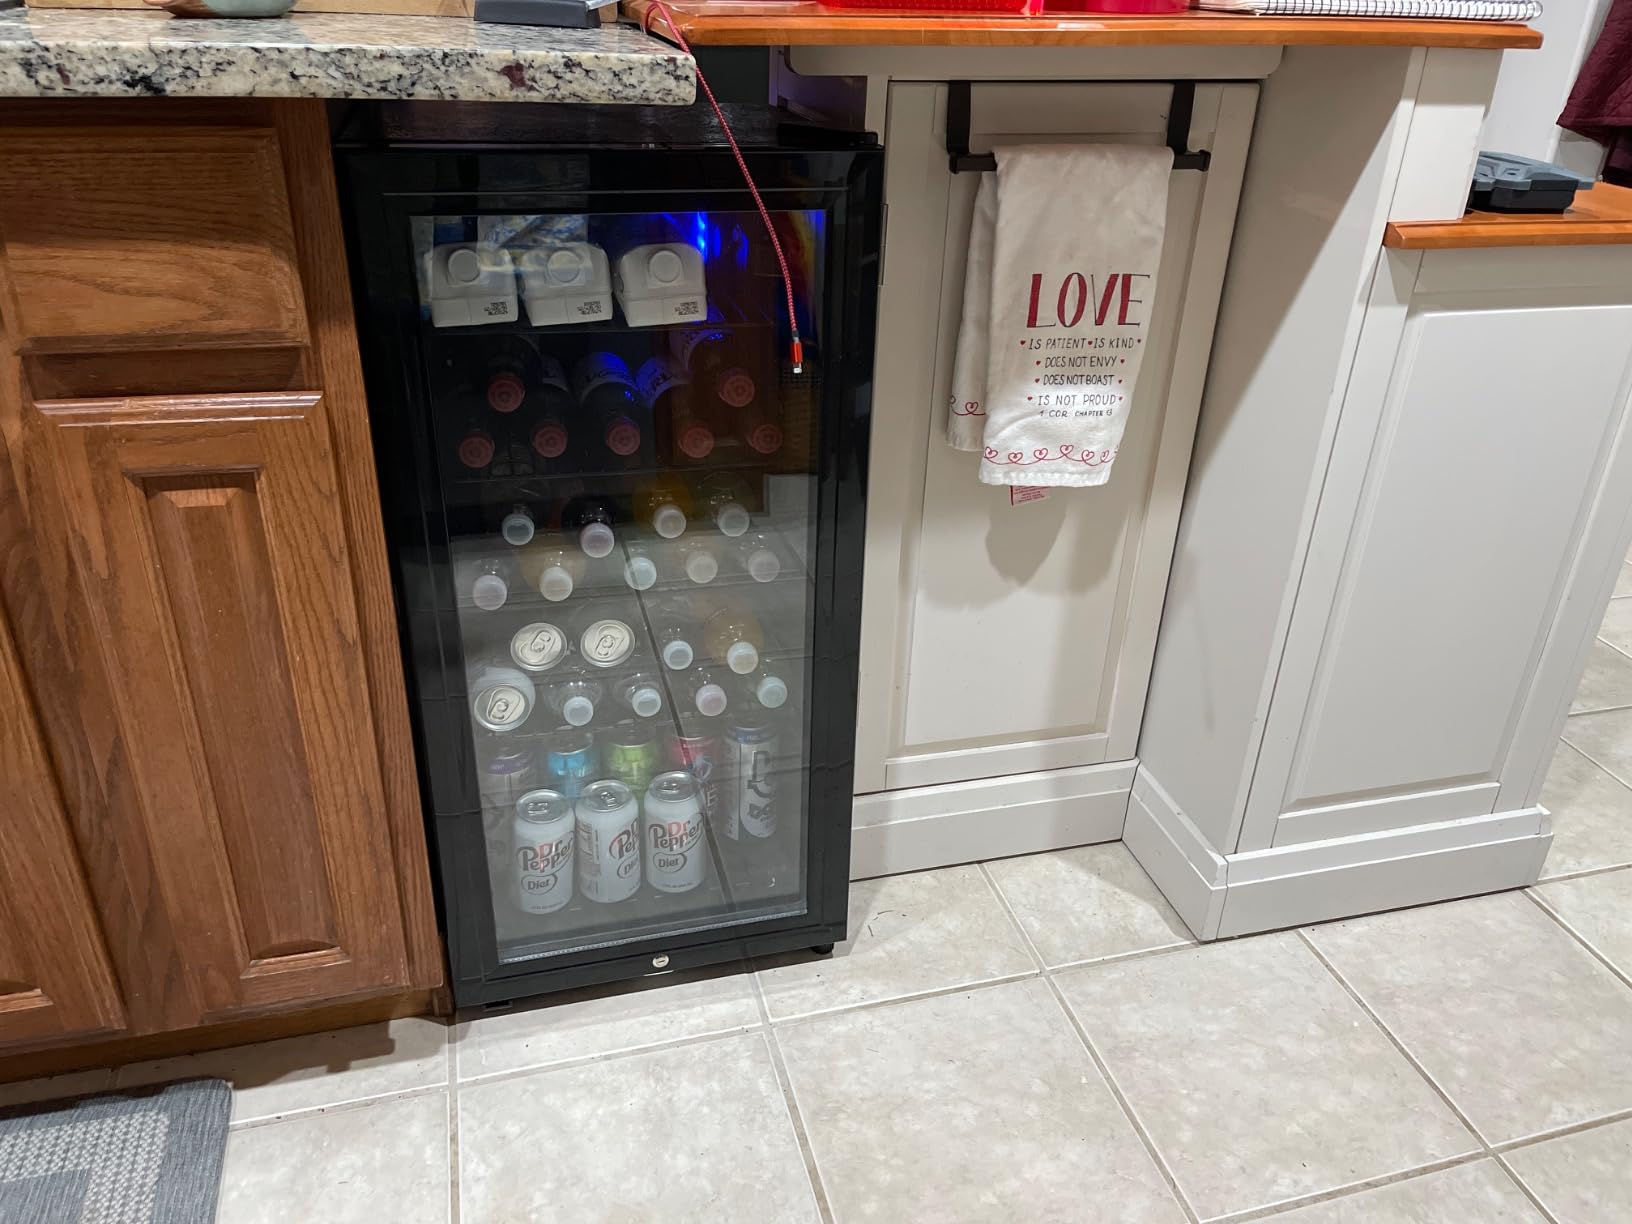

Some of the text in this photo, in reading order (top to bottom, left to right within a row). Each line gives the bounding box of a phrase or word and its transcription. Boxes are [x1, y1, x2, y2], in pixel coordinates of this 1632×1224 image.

[1027, 272, 1150, 328] LOVE
[1029, 337, 1135, 350] IS PATIENT IS KIND
[1045, 355, 1117, 369] DOES NOT ENVY
[1043, 374, 1115, 386] DOES NOT BOAST
[1038, 394, 1117, 406] IS NOT PROUD
[1074, 410, 1104, 418] CHAPTER
[648, 820, 702, 852] Pepper
[516, 837, 573, 873] Pepper
[658, 858, 680, 868] Diet
[527, 879, 551, 890] Diet
